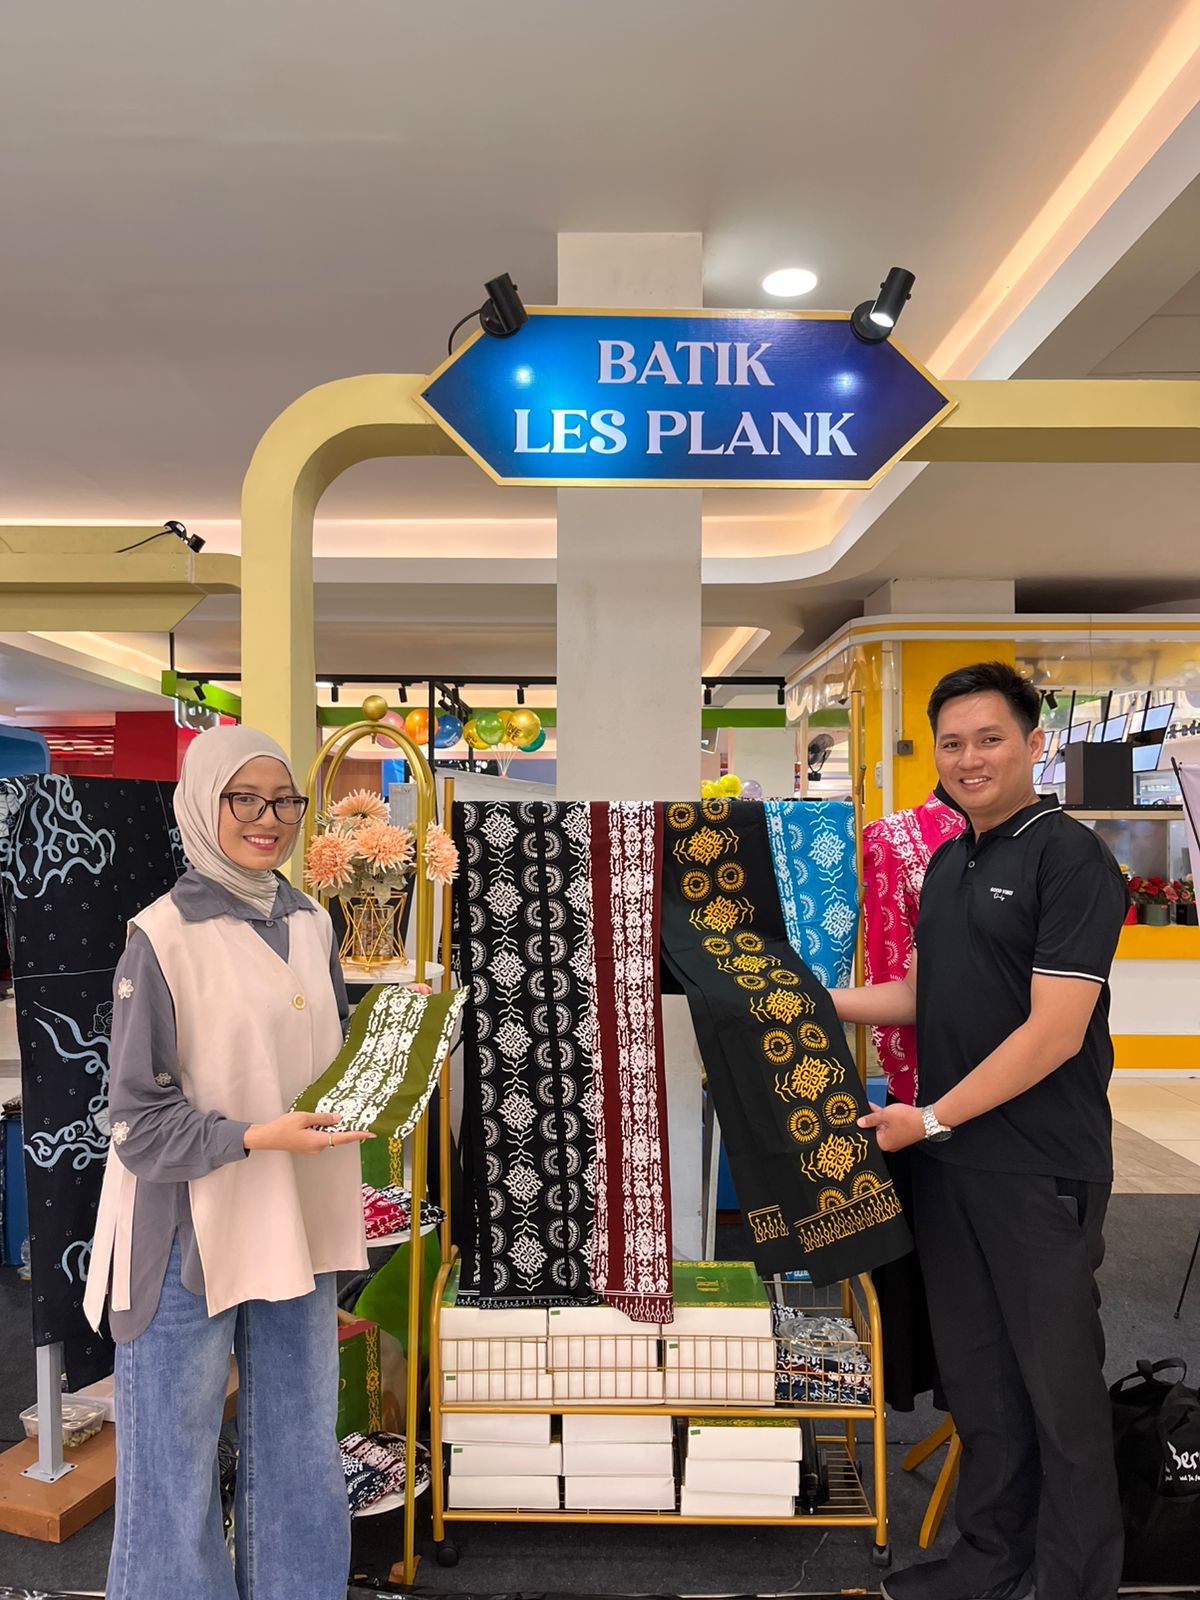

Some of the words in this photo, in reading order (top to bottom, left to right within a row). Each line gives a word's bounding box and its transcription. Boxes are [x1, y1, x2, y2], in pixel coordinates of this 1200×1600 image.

[597, 339, 775, 387] BATIK
[513, 408, 628, 455] LES
[645, 410, 857, 457] PLANK
